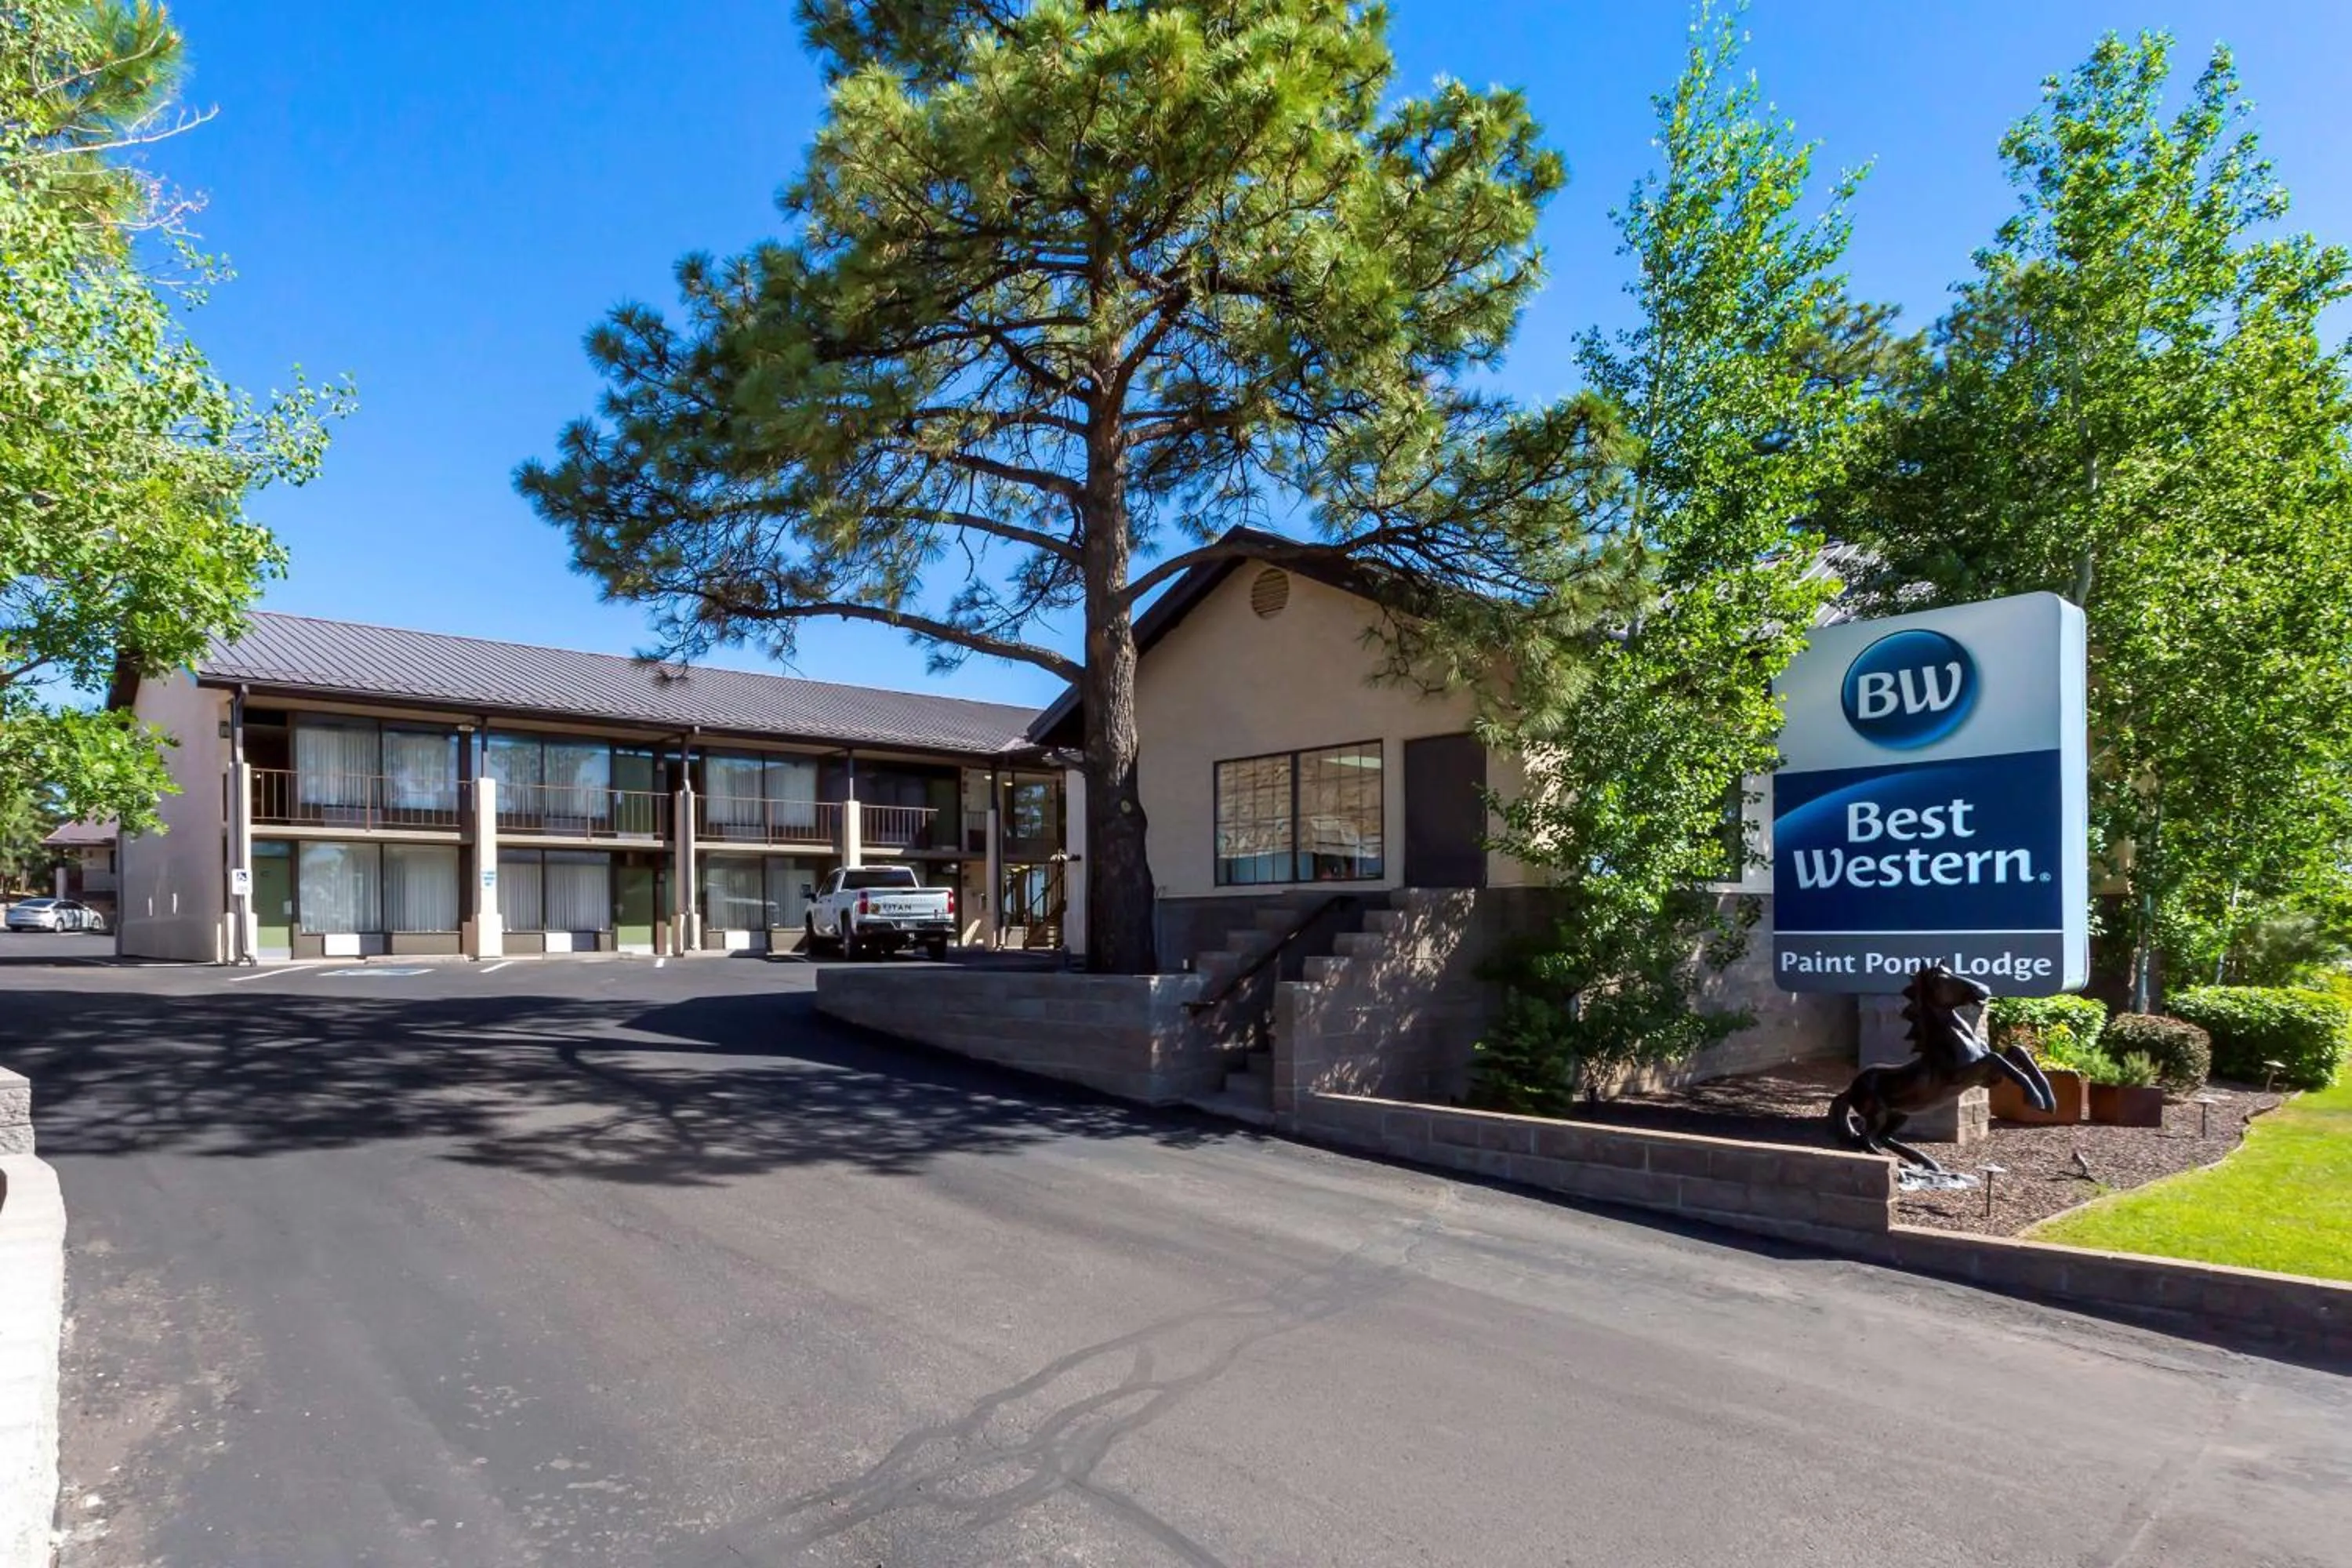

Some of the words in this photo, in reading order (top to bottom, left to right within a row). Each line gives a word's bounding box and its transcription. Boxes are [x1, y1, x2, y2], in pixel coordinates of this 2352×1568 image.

[1857, 662, 1962, 720] BW
[1847, 798, 1976, 843] Best
[1780, 950, 1857, 973] Paint
[1954, 951, 2053, 982] Lodge
